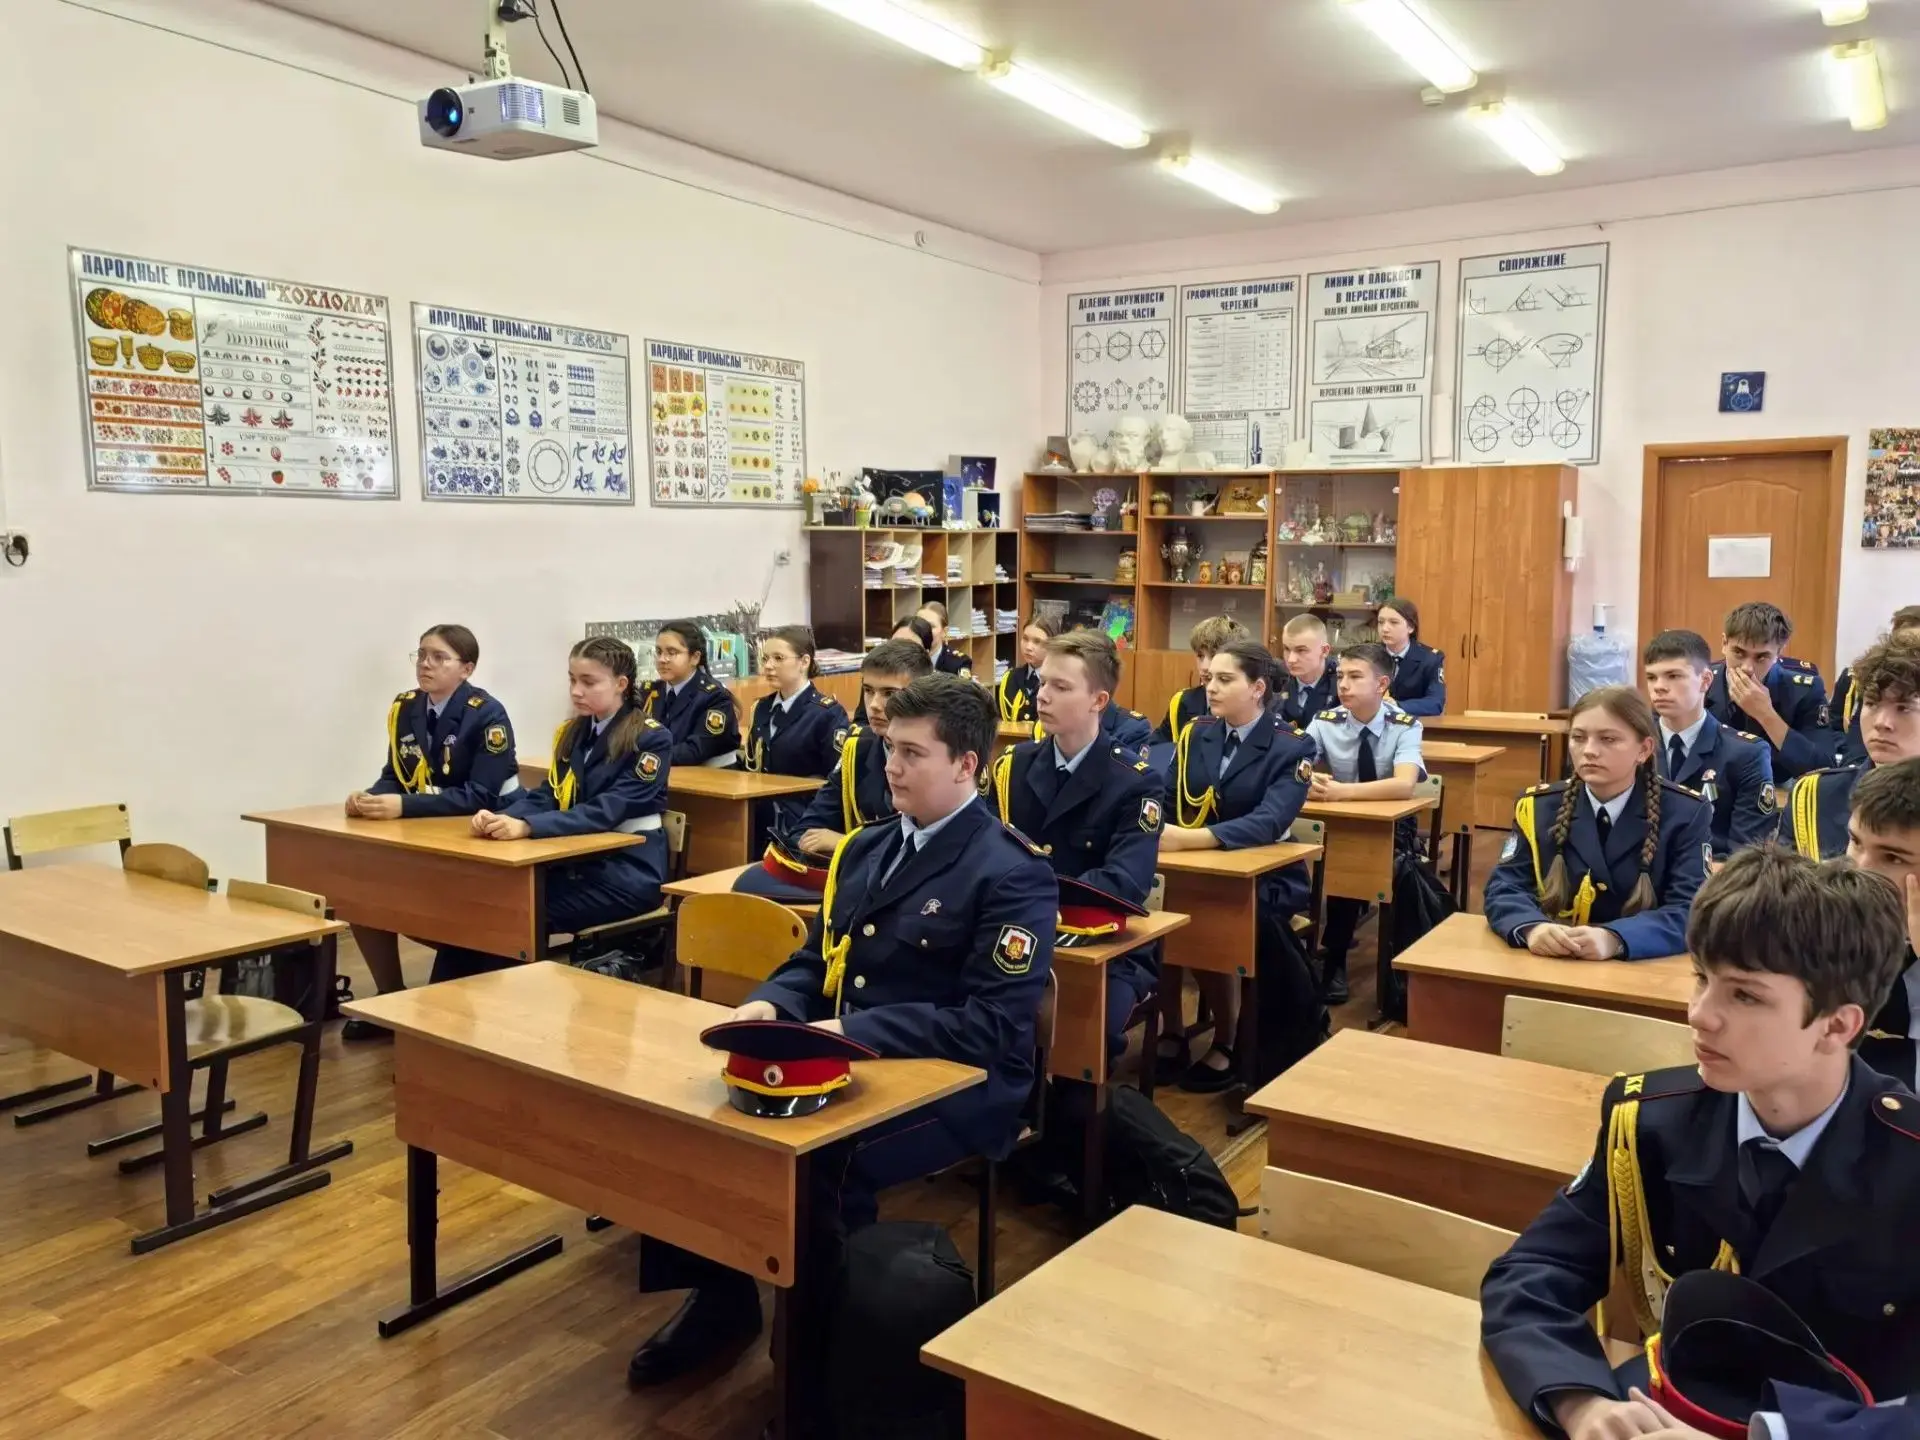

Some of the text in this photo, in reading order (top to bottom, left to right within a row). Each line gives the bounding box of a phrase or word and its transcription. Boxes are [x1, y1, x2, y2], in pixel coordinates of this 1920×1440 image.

[1499, 253, 1566, 272] СОПРЯЖЕНИЕ
[82, 253, 170, 285] НАРОДНЫЕ
[177, 268, 266, 299] ПРОМЫСЛЫ
[1324, 268, 1422, 288] ЛИНИИ И ПЛОСКОСТИ
[1186, 281, 1294, 300] ГРАФИЧЕСКОЕ ОФОРМЛЕНИЕ
[1336, 286, 1407, 303] В ПЕРСПЕКТИВЕ
[1078, 292, 1165, 310] ДЕЛЕНИЕ ОКРУЖНОСТИ
[1221, 297, 1258, 311] ЧЕРТЕЖЕЙ
[1086, 307, 1156, 322] НА РАВНЫЕ ЧАСТИ
[429, 309, 488, 333] НАРОДНЫЕ
[492, 318, 552, 341] ПРОМЫСЛЫ
[651, 343, 694, 362] НАРОДНЫЕ
[697, 350, 742, 368] ПРОМЫСЛЫ
[1624, 1074, 1645, 1096] КК
